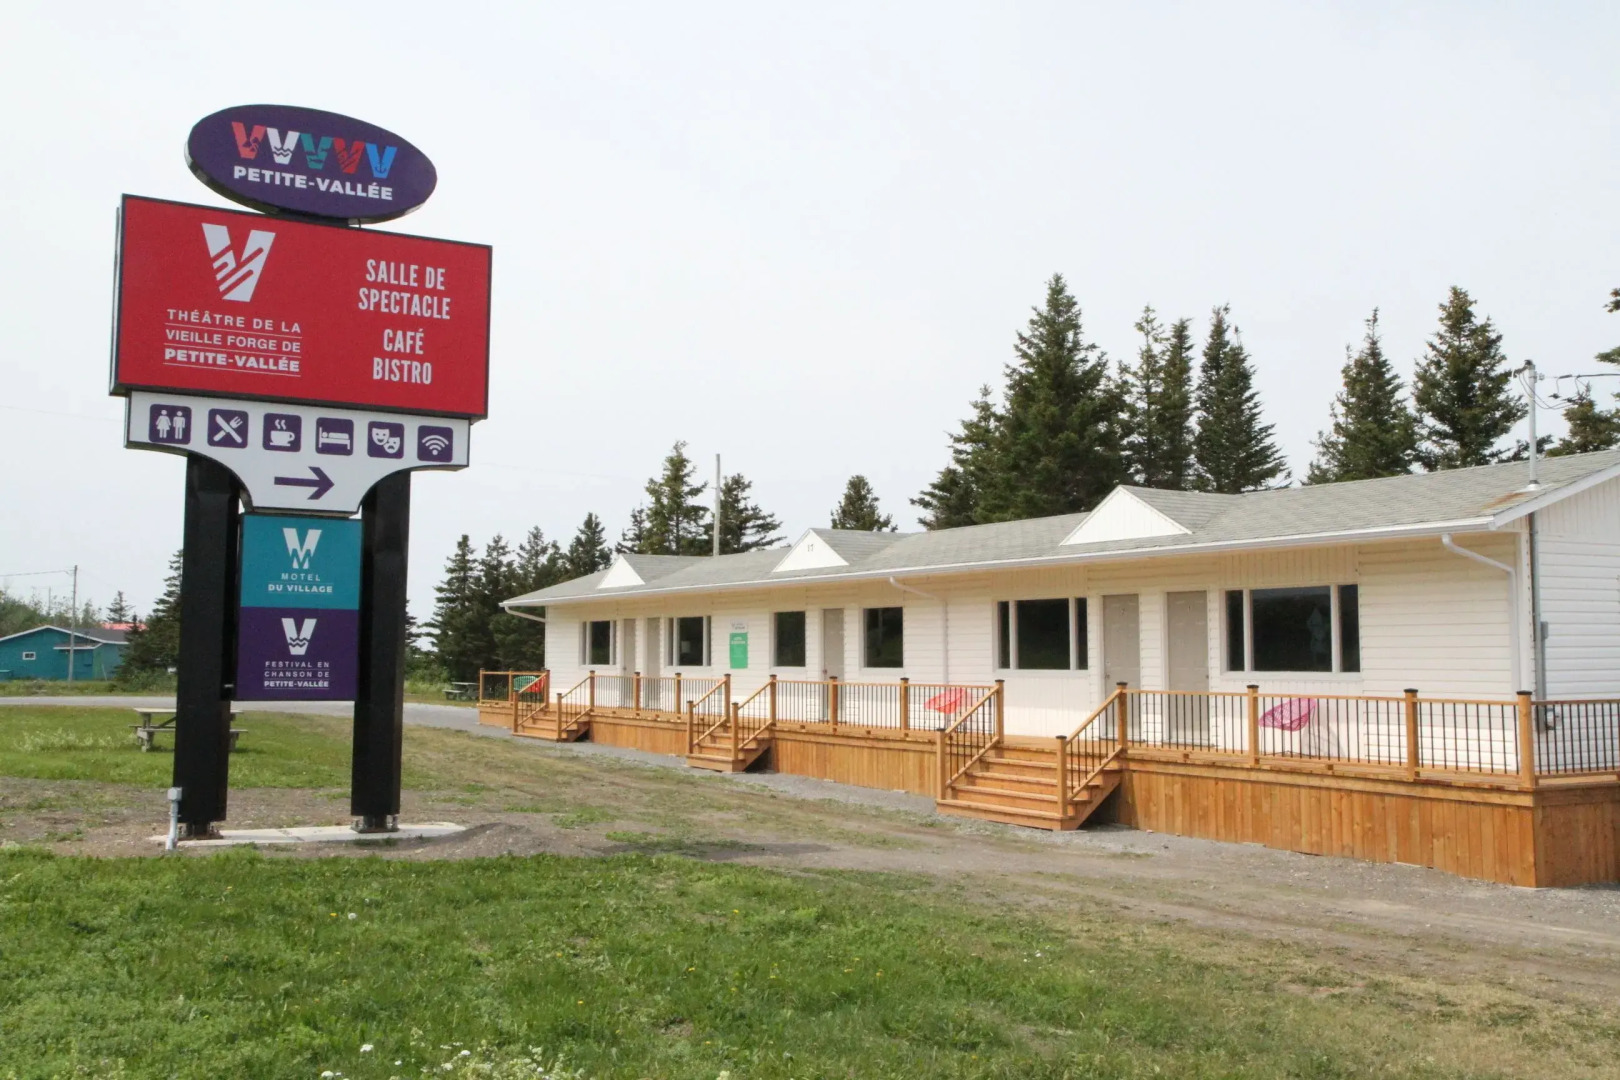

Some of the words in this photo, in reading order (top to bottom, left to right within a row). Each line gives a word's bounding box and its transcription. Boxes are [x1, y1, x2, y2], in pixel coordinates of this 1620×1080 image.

[233, 165, 393, 201] PETITE-VALLÉE
[365, 258, 419, 287] SALLE
[425, 266, 446, 290] DE
[358, 287, 451, 320] SPECTACLE
[167, 308, 245, 328] THÉÂTRE
[252, 318, 274, 331] DE
[281, 321, 301, 333] LA
[165, 329, 222, 345] VIEILLE
[227, 336, 277, 351] FORGE
[282, 342, 301, 353] DE
[383, 328, 424, 355] CAFÉ
[164, 347, 300, 372] PETITE-VALLÉE
[373, 357, 432, 385] BISTRO
[268, 584, 283, 592] DU
[287, 584, 333, 593] VILLAGE
[281, 572, 321, 582] MOTEL
[264, 679, 330, 688] PETITE-VALLÉE
